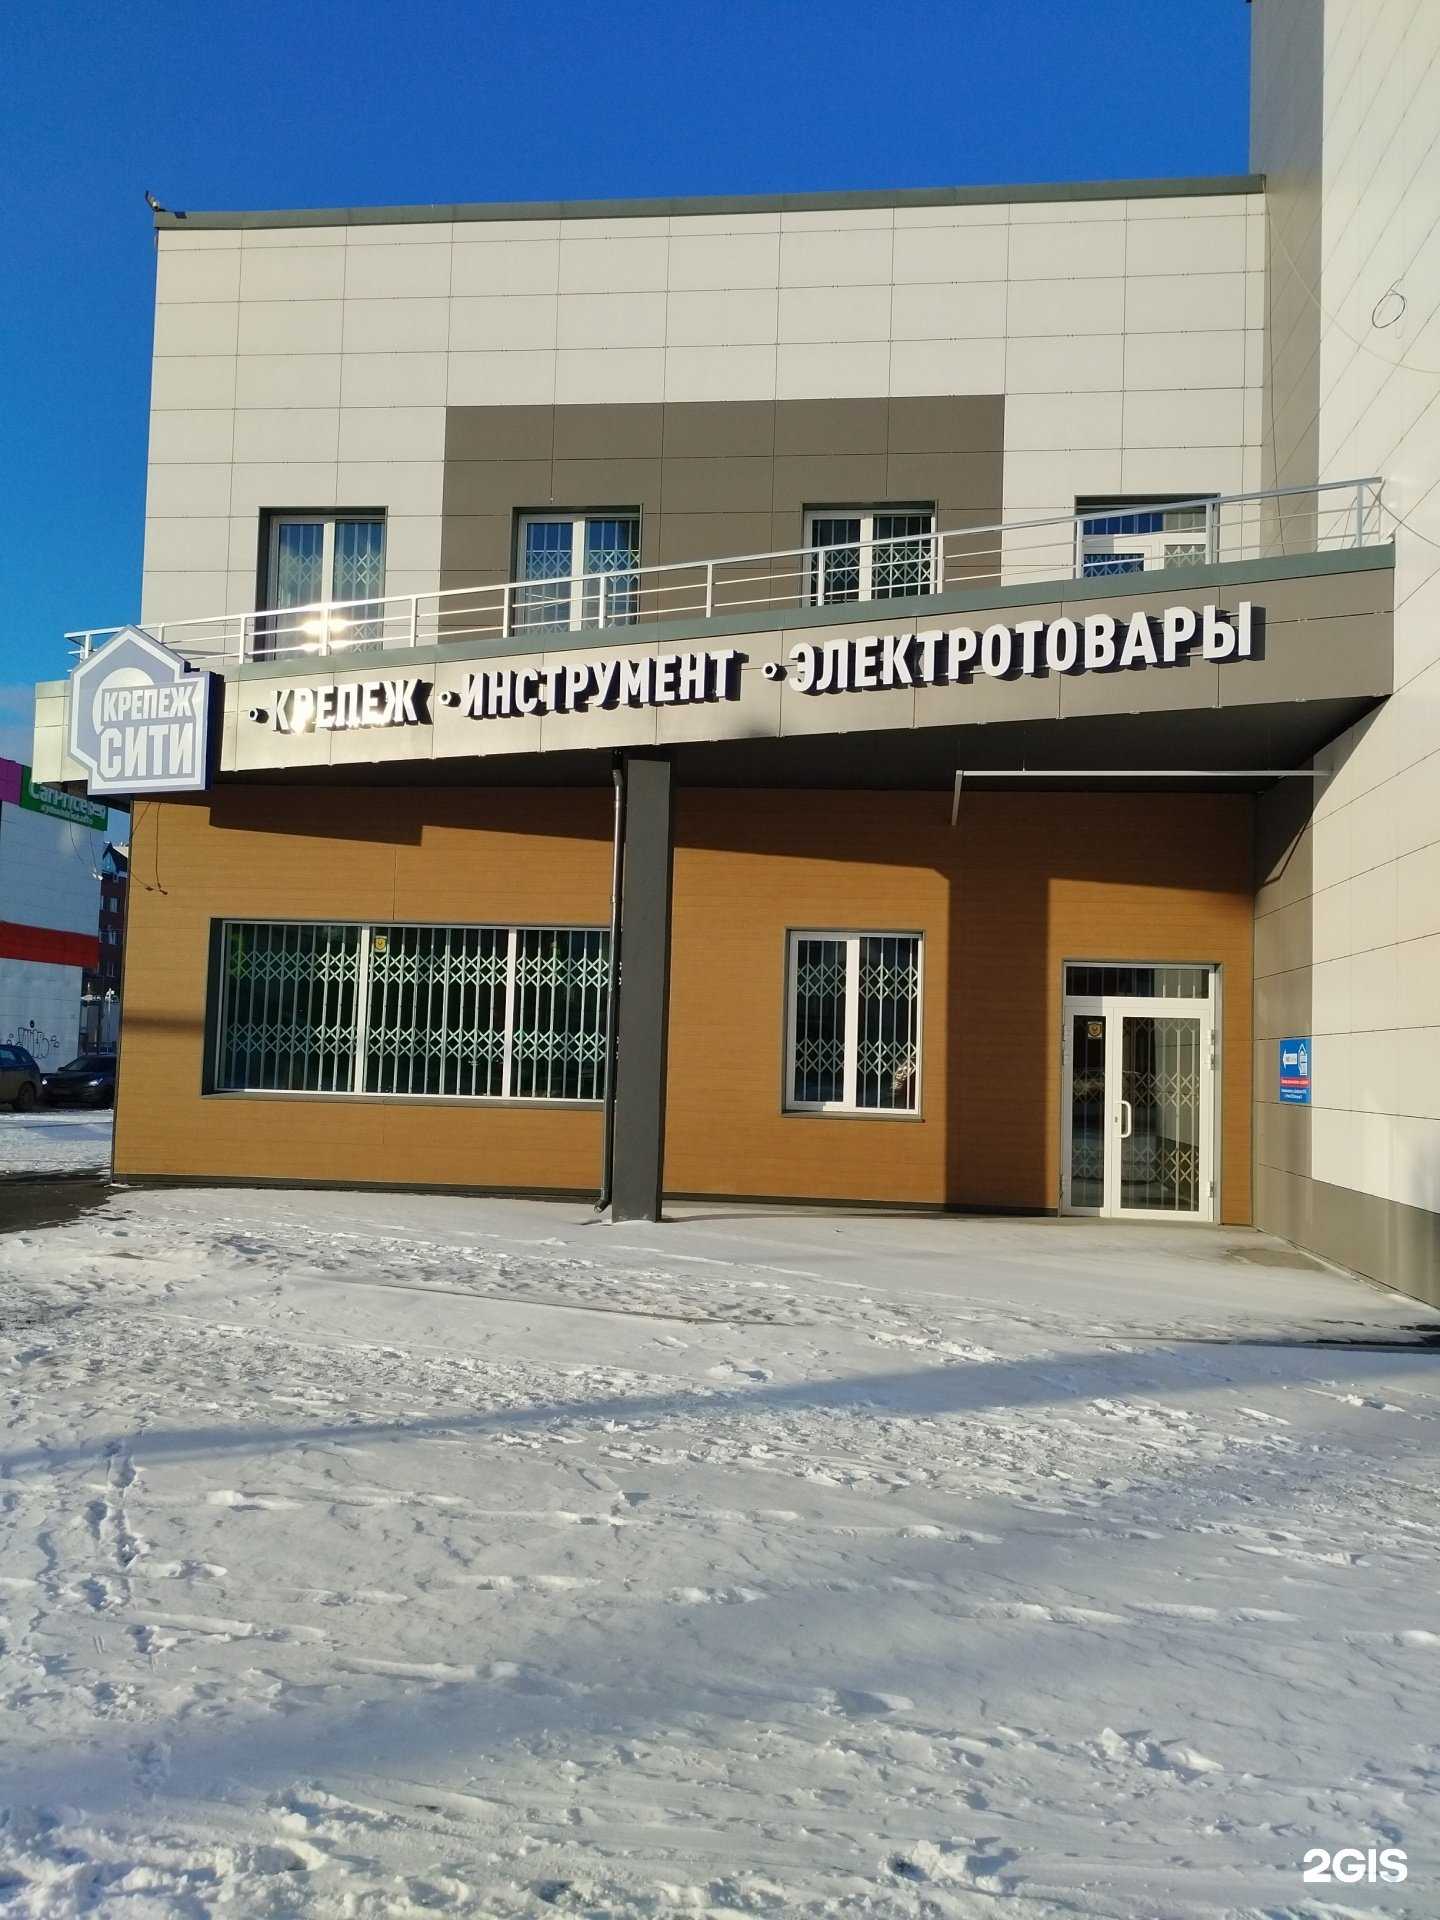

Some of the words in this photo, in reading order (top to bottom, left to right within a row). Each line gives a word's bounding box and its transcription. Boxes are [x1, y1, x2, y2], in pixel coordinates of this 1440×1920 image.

[270, 678, 419, 733] КРЕПЕЖ
[460, 649, 738, 717] ИНСТРУМЕНТ
[788, 601, 1253, 693] ЭЛЕКТРОТОВАРЫ
[103, 686, 193, 722] КРЕПЕЖ
[100, 722, 194, 778] СИТИ
